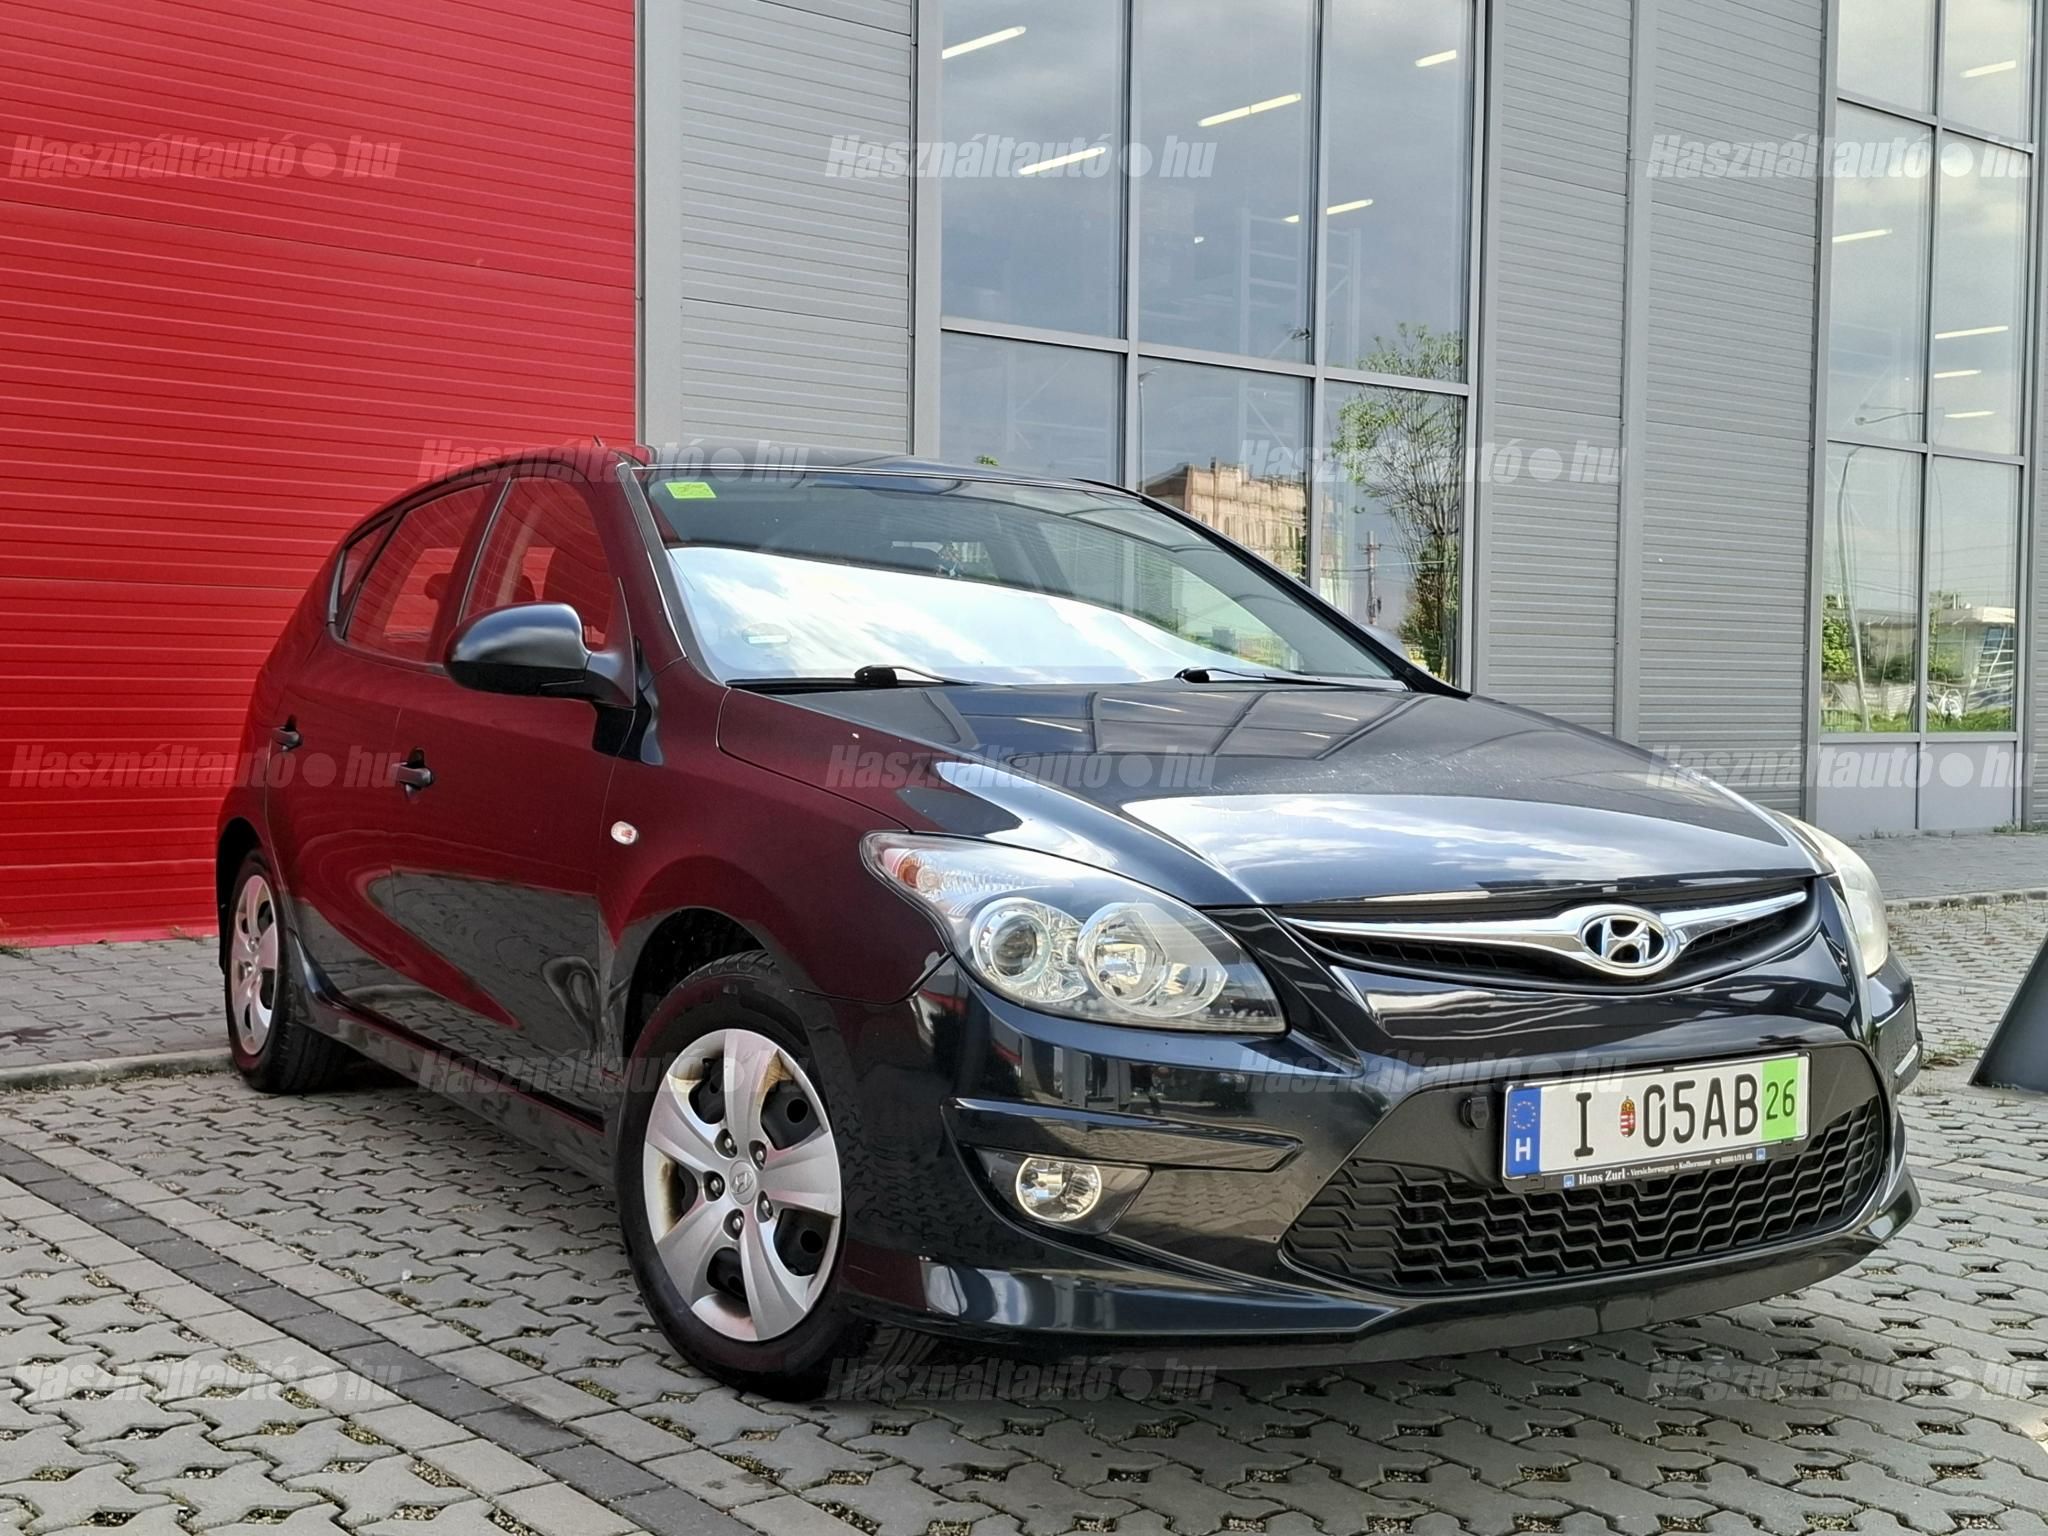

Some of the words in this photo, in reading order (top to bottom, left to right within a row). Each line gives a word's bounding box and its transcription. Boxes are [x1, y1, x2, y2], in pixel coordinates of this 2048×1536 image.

[1573, 1091, 1594, 1158] I
[1642, 1074, 1758, 1148] 05AB
[1765, 1079, 1796, 1120] 26
[1514, 1137, 1532, 1162] H
[1578, 1172, 1603, 1185] Hans
[1605, 1167, 1626, 1181] Zurl
